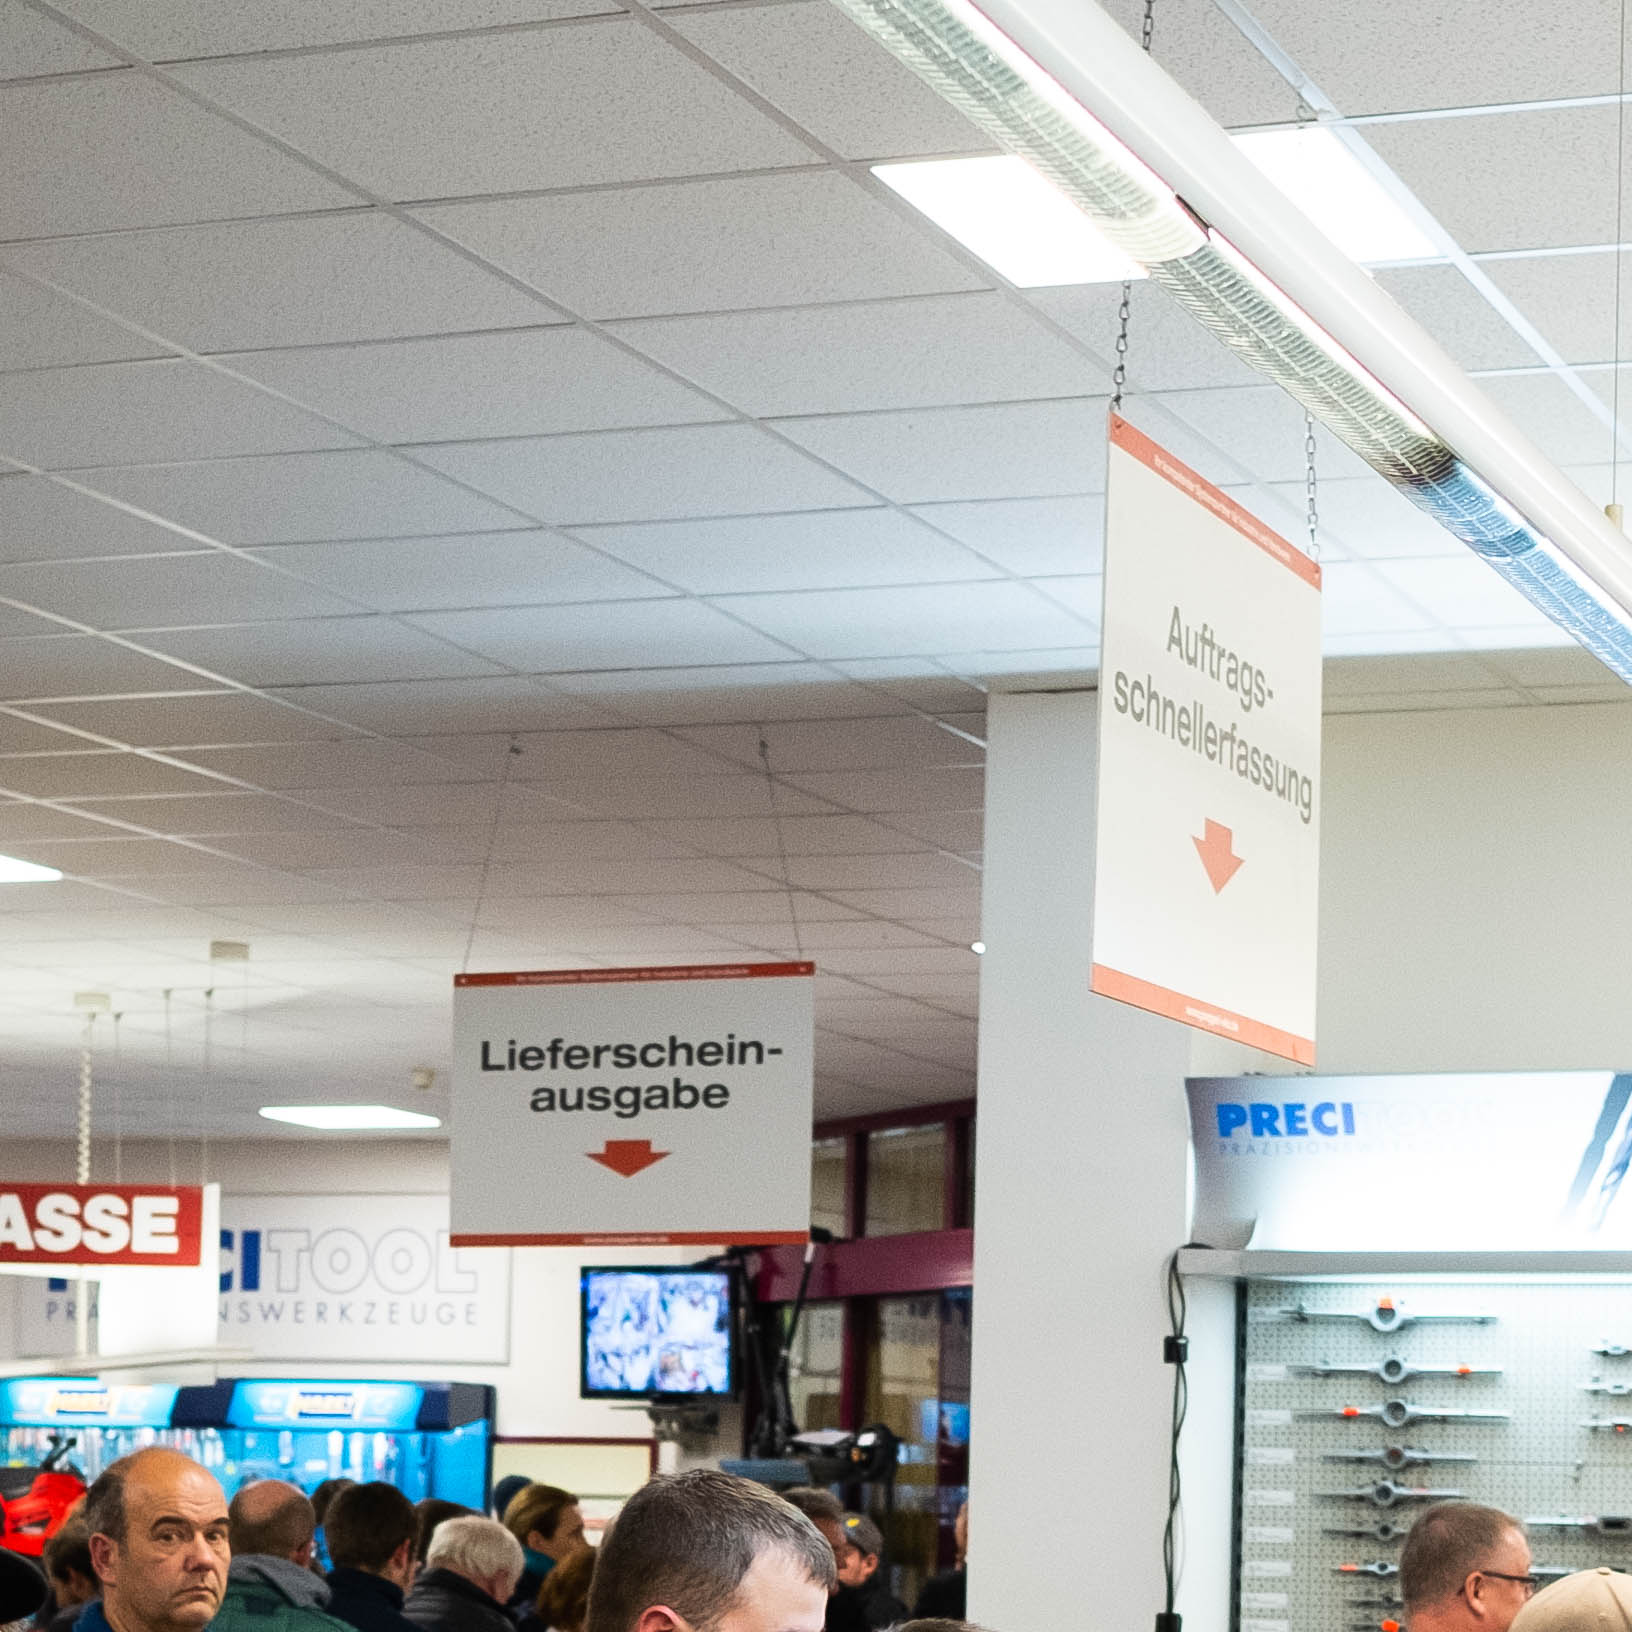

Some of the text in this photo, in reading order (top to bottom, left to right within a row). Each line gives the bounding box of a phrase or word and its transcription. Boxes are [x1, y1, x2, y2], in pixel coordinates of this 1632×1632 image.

[1166, 604, 1275, 713] Auftrags-
[1112, 668, 1313, 825] schnellerfassung
[480, 1033, 784, 1072] Lieferschein-
[529, 1077, 731, 1119] ausgabe
